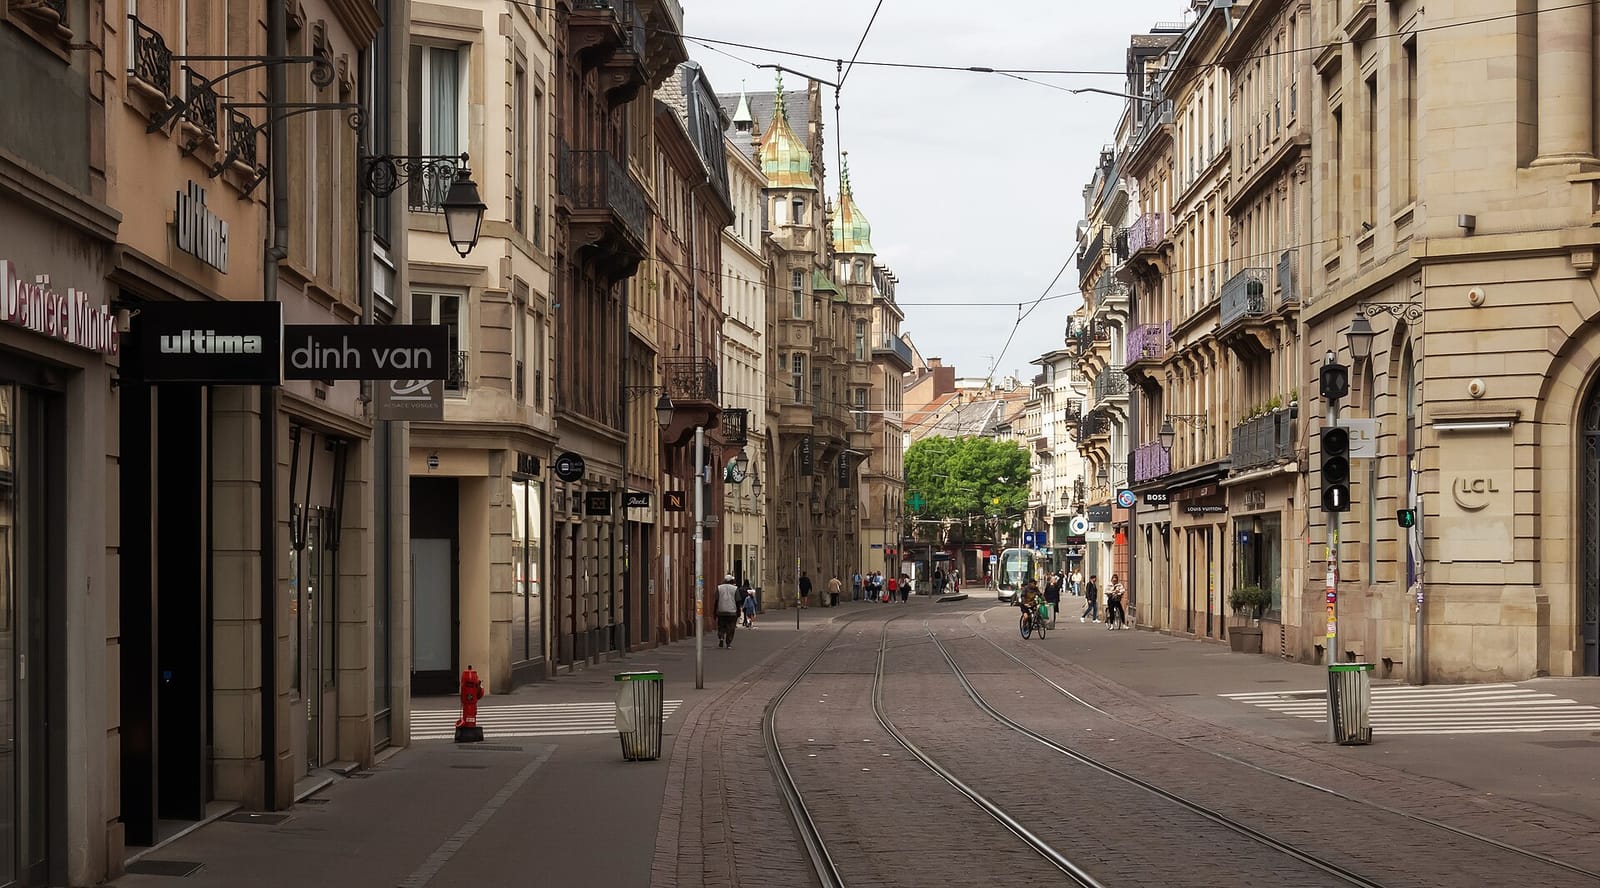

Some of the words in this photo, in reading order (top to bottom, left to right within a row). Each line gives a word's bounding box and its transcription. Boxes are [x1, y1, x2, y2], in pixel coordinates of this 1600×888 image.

[176, 180, 229, 275] ultima
[67, 287, 119, 356] Minute
[160, 335, 263, 354] ultima
[291, 336, 361, 370] dinh
[371, 348, 432, 370] van
[1349, 430, 1370, 440] CL
[1461, 479, 1499, 494] LCL
[1146, 493, 1167, 501] BOSS
